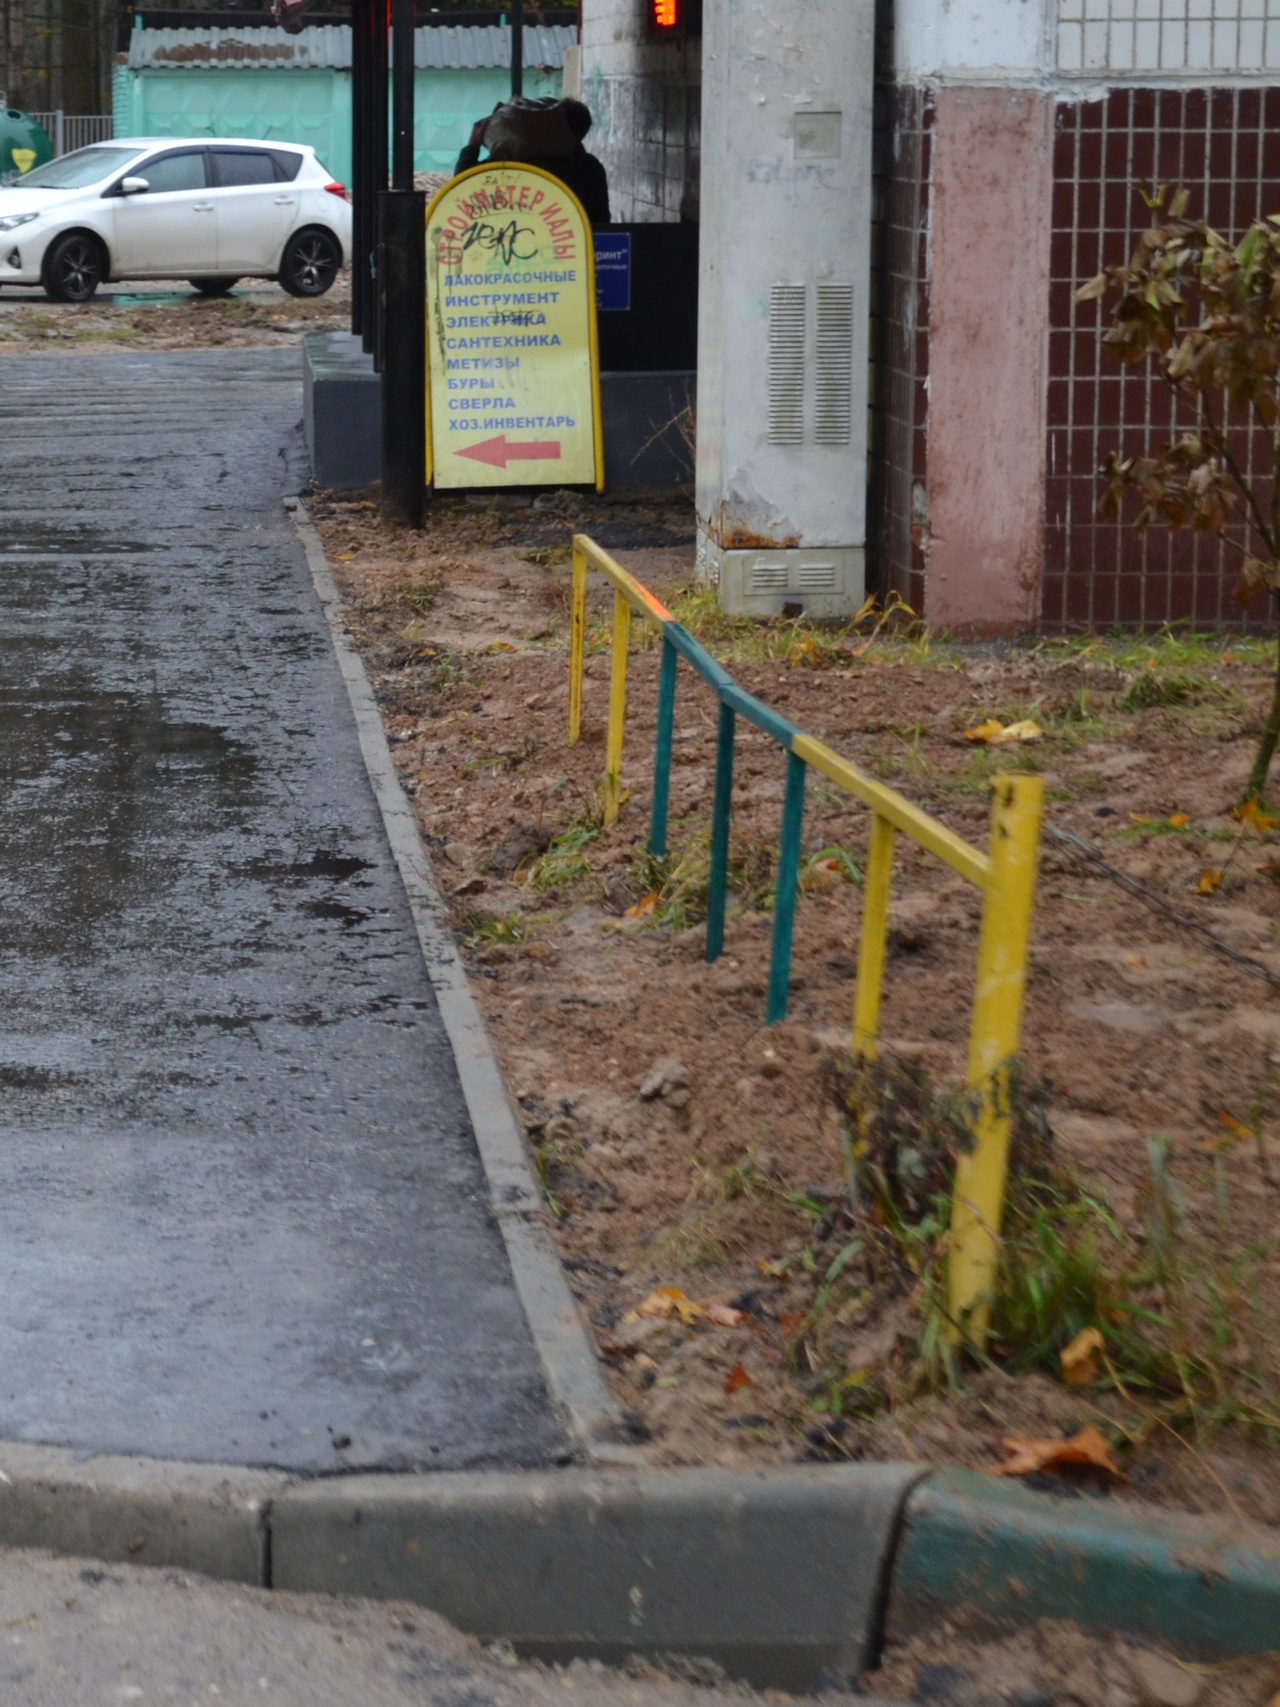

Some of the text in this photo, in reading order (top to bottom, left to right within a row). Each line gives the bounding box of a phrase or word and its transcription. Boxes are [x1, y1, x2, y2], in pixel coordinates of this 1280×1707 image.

[438, 184, 577, 266] СТРОЙМАТЕРИАЛЫ
[444, 270, 577, 287] ЛАКОКРАСОЧНЫЕ
[444, 292, 560, 308] ИНСТРУМЕНТ
[445, 313, 547, 329] ЭЛЕКТРИКА
[446, 334, 561, 350] САНТЕХНИКА
[446, 357, 520, 370] МЕТИЗЫ
[447, 378, 495, 390] БУРЫ
[448, 397, 516, 411] СВЕРЛА
[448, 415, 576, 431] ХОЗ.ИНВЕНТАРЬ
